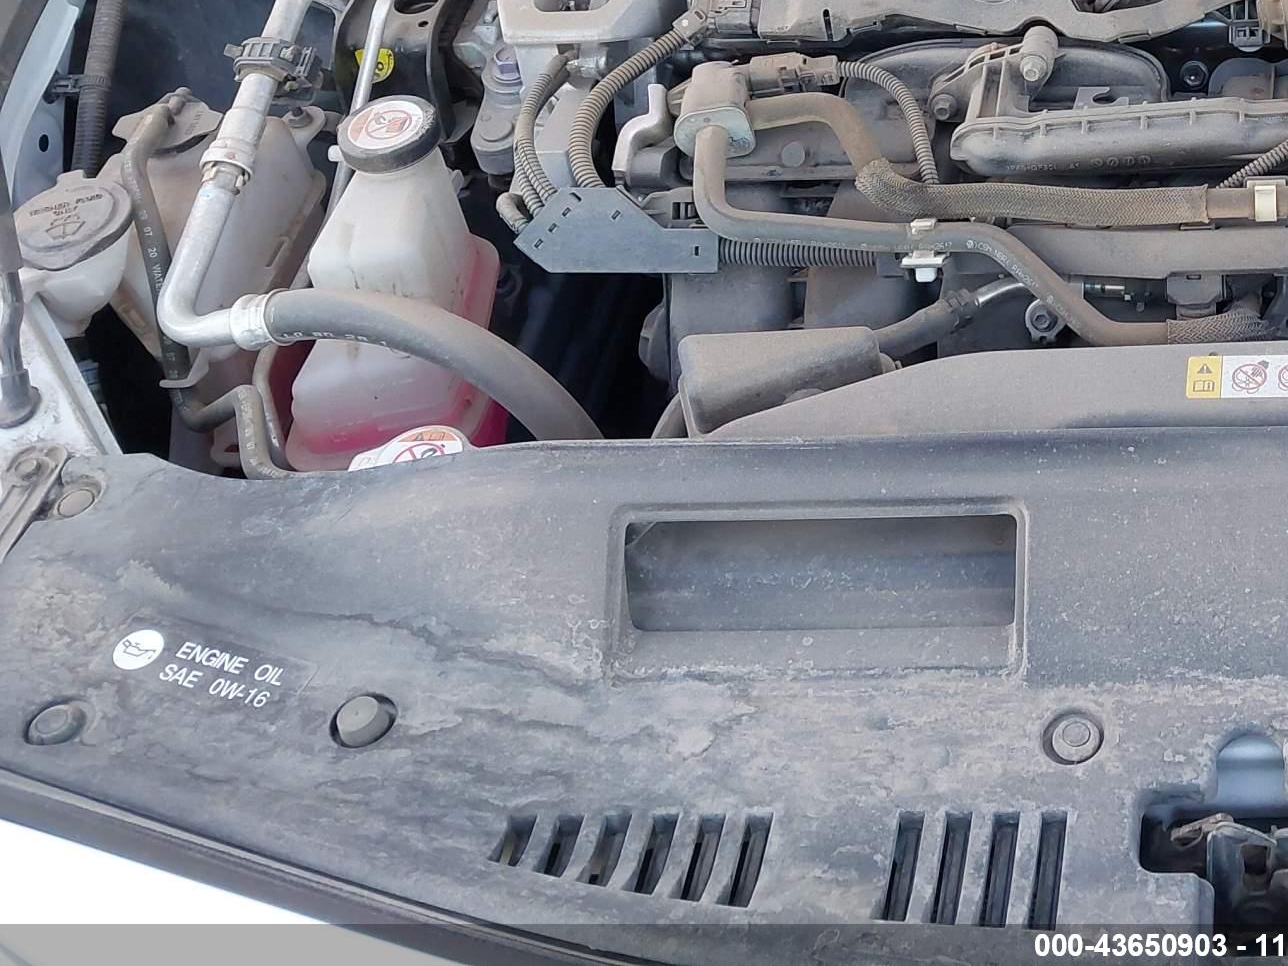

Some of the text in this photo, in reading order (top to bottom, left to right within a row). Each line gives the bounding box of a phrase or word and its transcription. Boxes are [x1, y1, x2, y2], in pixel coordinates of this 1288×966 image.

[143, 227, 153, 236] 07
[148, 247, 157, 258] 20
[159, 663, 271, 708] SAE 0W-16
[175, 641, 284, 686] ENGINE OIL
